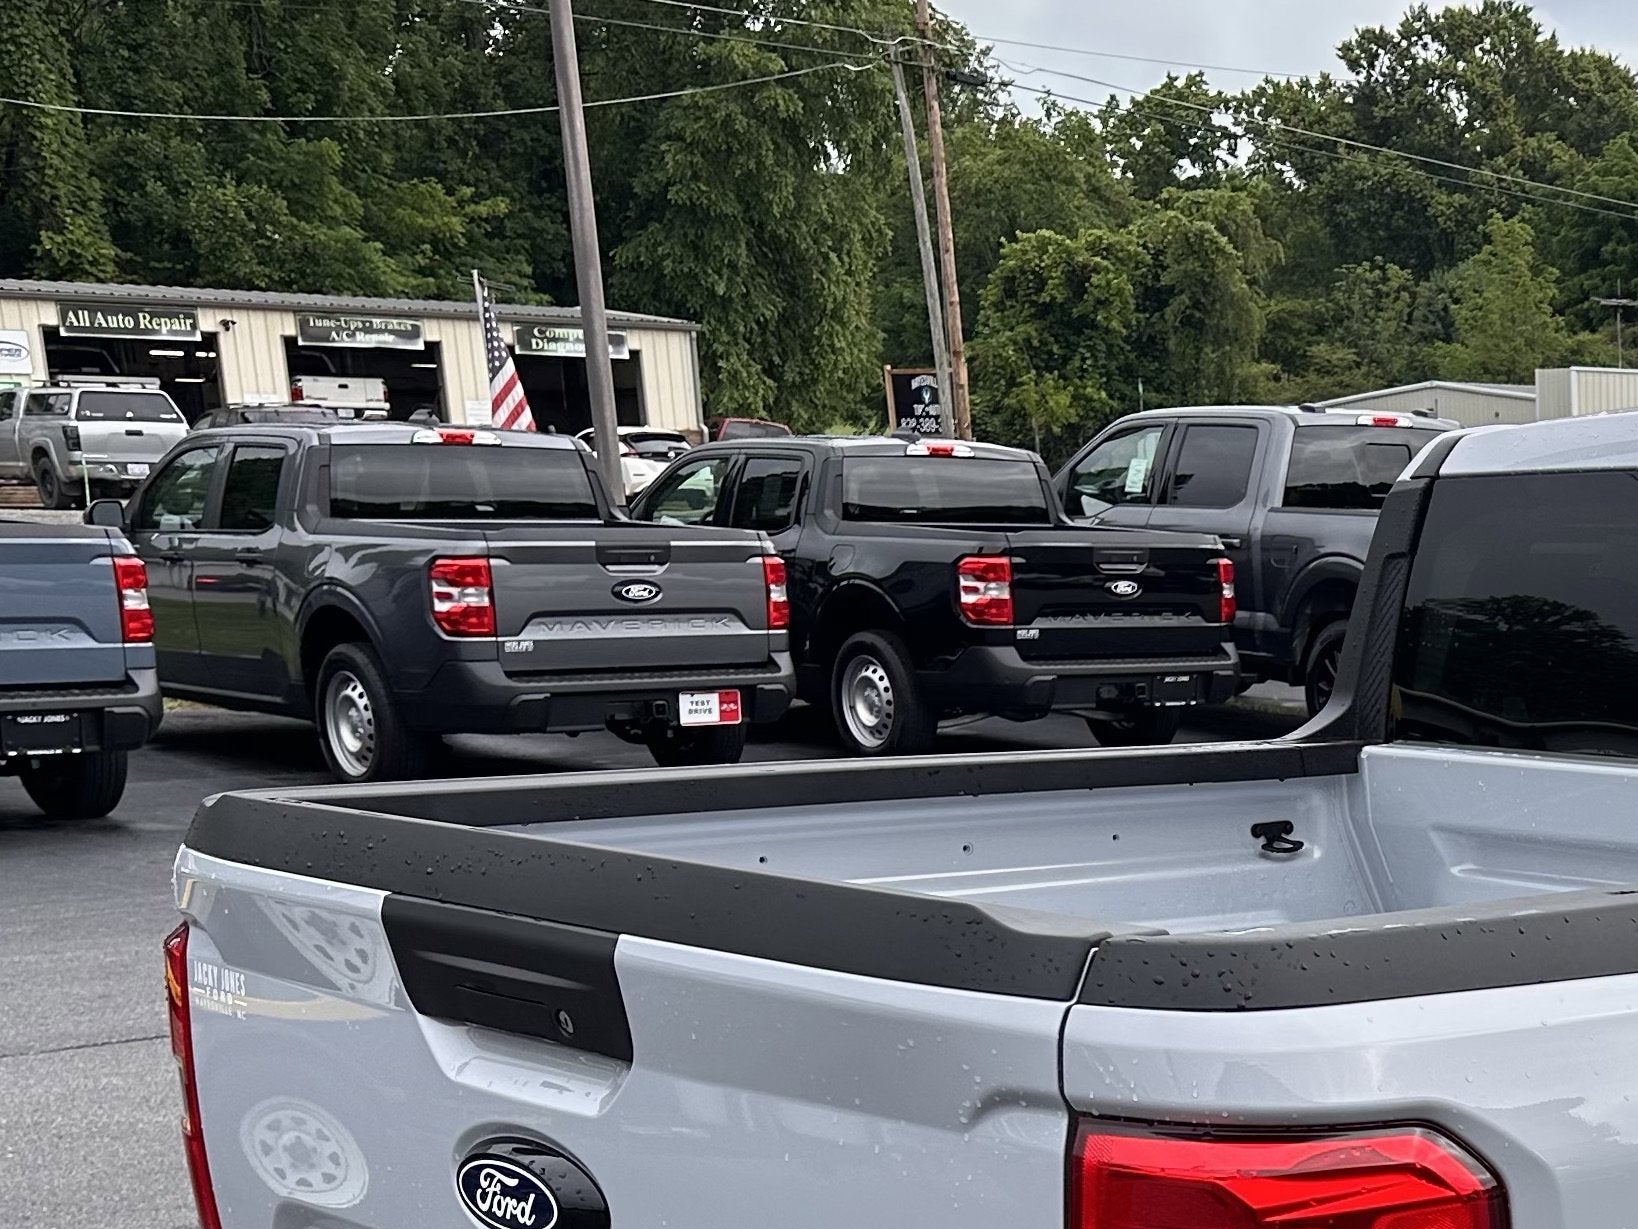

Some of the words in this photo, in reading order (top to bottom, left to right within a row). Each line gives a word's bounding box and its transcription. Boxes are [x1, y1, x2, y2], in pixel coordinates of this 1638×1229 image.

[65, 310, 91, 327] All
[94, 312, 135, 329] Auto
[139, 313, 193, 334] Repair
[309, 316, 363, 340] Tune-Ups
[329, 331, 353, 342] A/C
[540, 616, 731, 634] MAVERICK
[193, 960, 218, 989] JACKY
[221, 968, 246, 997] JONES
[206, 987, 233, 1005] FORD
[476, 1167, 536, 1227] Ford
